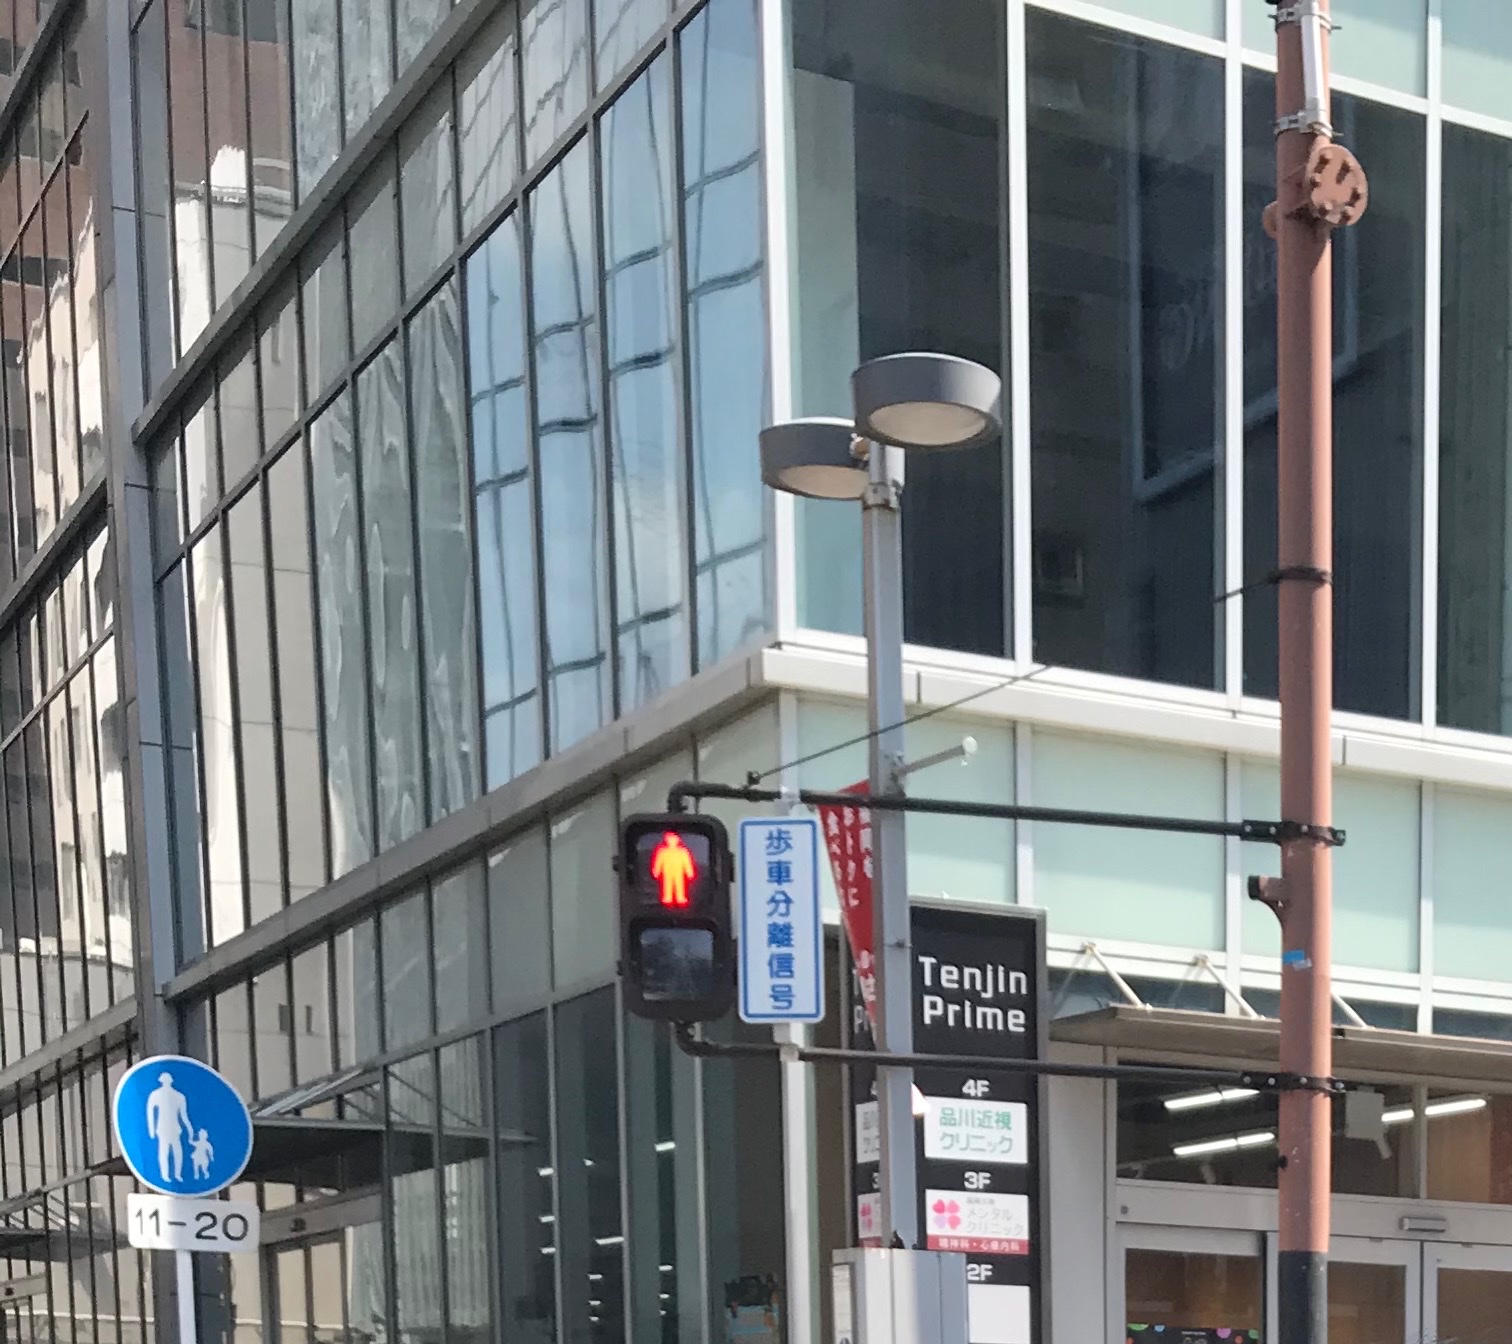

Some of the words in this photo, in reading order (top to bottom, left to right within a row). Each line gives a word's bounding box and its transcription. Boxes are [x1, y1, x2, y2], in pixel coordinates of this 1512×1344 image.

[765, 829, 795, 1010] 歩車分離信号
[918, 956, 1028, 998] Tenjin
[923, 996, 1026, 1033] Prime
[962, 1079, 990, 1097] 4F
[939, 1107, 1012, 1130] 品川近視
[939, 1132, 1013, 1154] クリニック
[964, 1172, 991, 1189] 3F
[135, 1208, 249, 1241] 11-20
[967, 1264, 993, 1281] 2F
